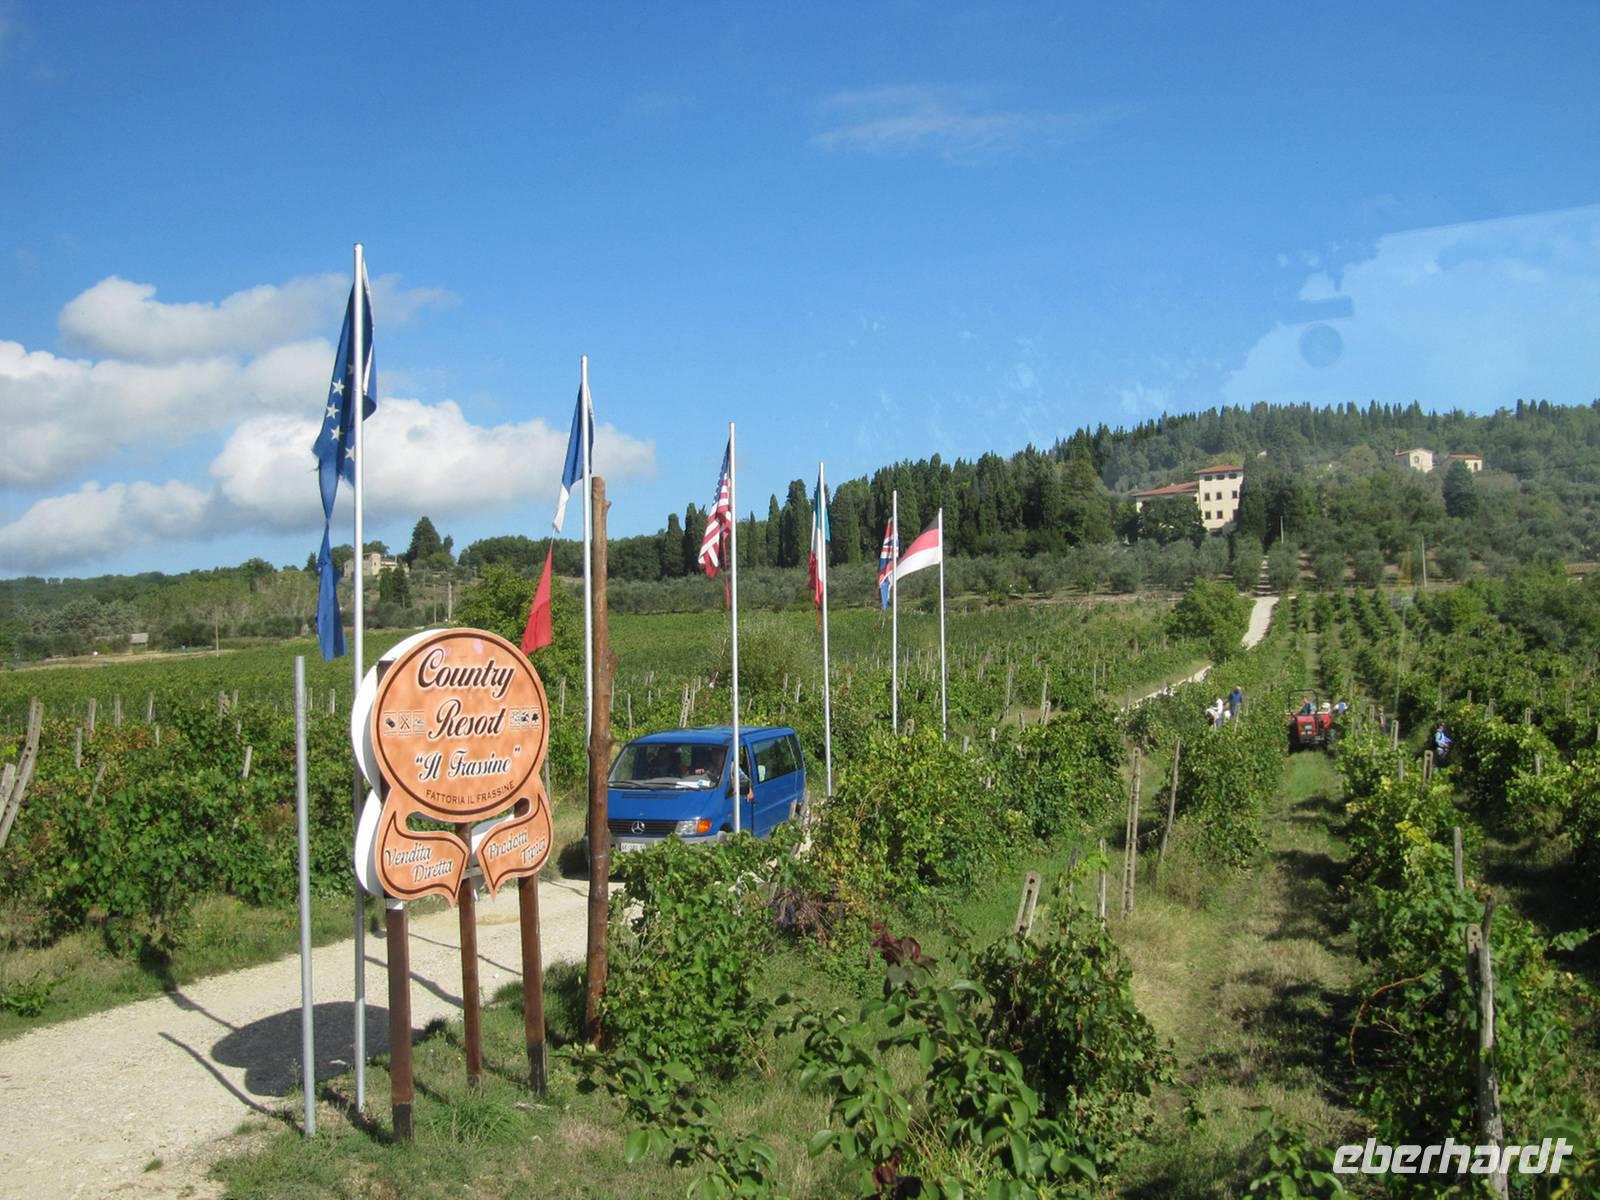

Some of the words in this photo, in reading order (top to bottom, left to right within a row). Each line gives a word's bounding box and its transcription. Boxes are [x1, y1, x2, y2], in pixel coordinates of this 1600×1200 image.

[418, 648, 514, 698] Country
[428, 699, 506, 740] Resort
[425, 789, 466, 803] FATTORIA
[467, 795, 475, 804] IL
[476, 780, 515, 804] FRASSINE
[384, 842, 432, 866] Vendita
[413, 861, 453, 882] Diretta
